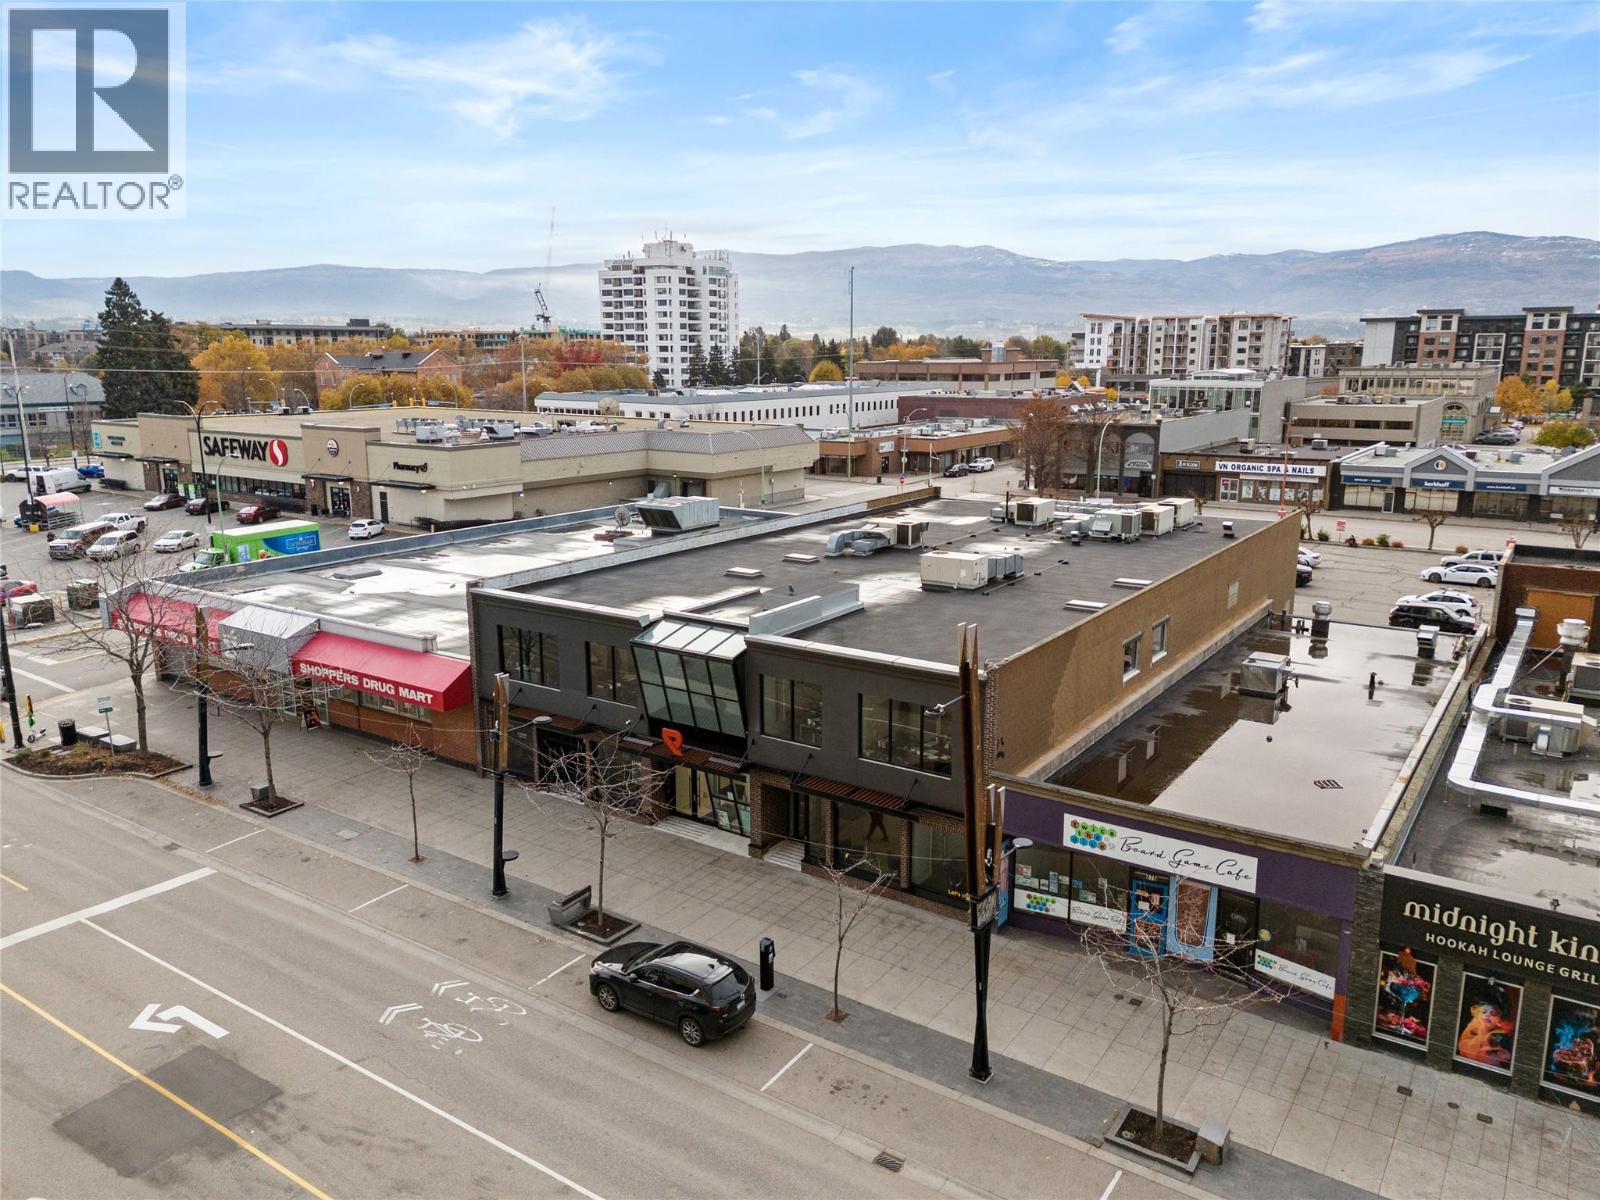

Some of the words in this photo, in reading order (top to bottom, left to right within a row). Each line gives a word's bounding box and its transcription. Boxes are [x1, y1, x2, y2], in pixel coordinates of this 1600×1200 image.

[203, 436, 268, 461] SAFEWAY
[1218, 462, 1228, 470] VN
[1231, 463, 1264, 472] ORGANIC
[1267, 465, 1281, 473] SPA
[1291, 466, 1315, 474] NAILS
[300, 663, 359, 685] SHOPPERS
[363, 677, 395, 695] DRUG
[399, 686, 433, 704] MART
[1120, 836, 1166, 858] Board
[1168, 848, 1212, 868] Game
[1403, 900, 1538, 946] midnight
[1426, 932, 1488, 957] HOOKAH
[1492, 949, 1555, 974] LOUNGE
